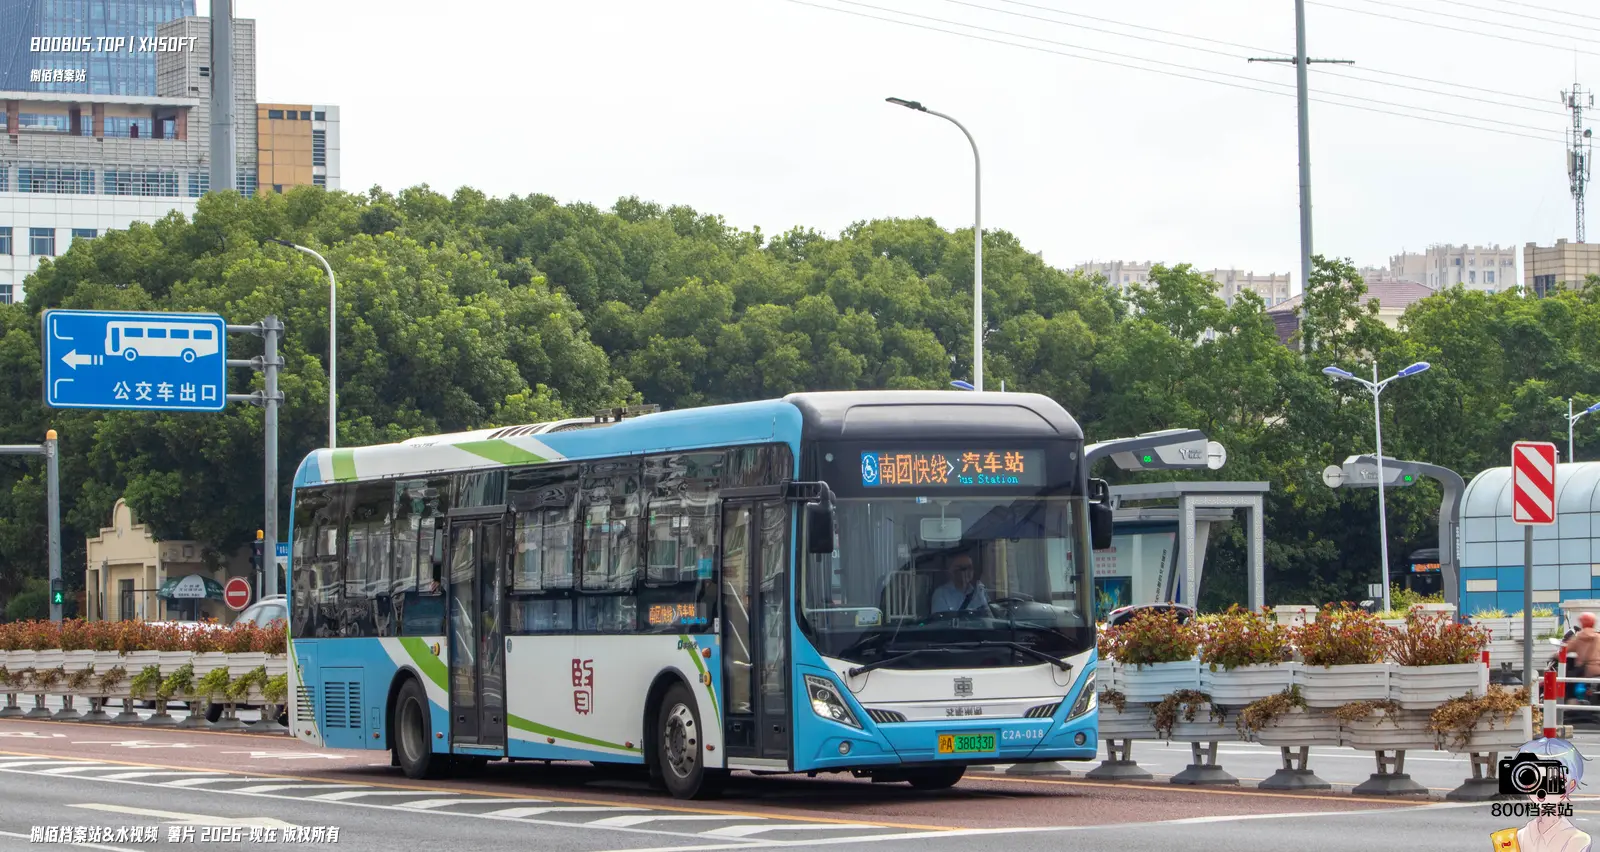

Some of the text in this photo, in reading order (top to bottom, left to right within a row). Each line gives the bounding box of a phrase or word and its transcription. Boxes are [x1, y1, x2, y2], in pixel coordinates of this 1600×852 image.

[112, 381, 217, 403] 公交车出口
[878, 451, 1025, 485] 南团快线 汽车站
[977, 473, 1019, 485] Station
[1002, 728, 1044, 740] C2A-018
